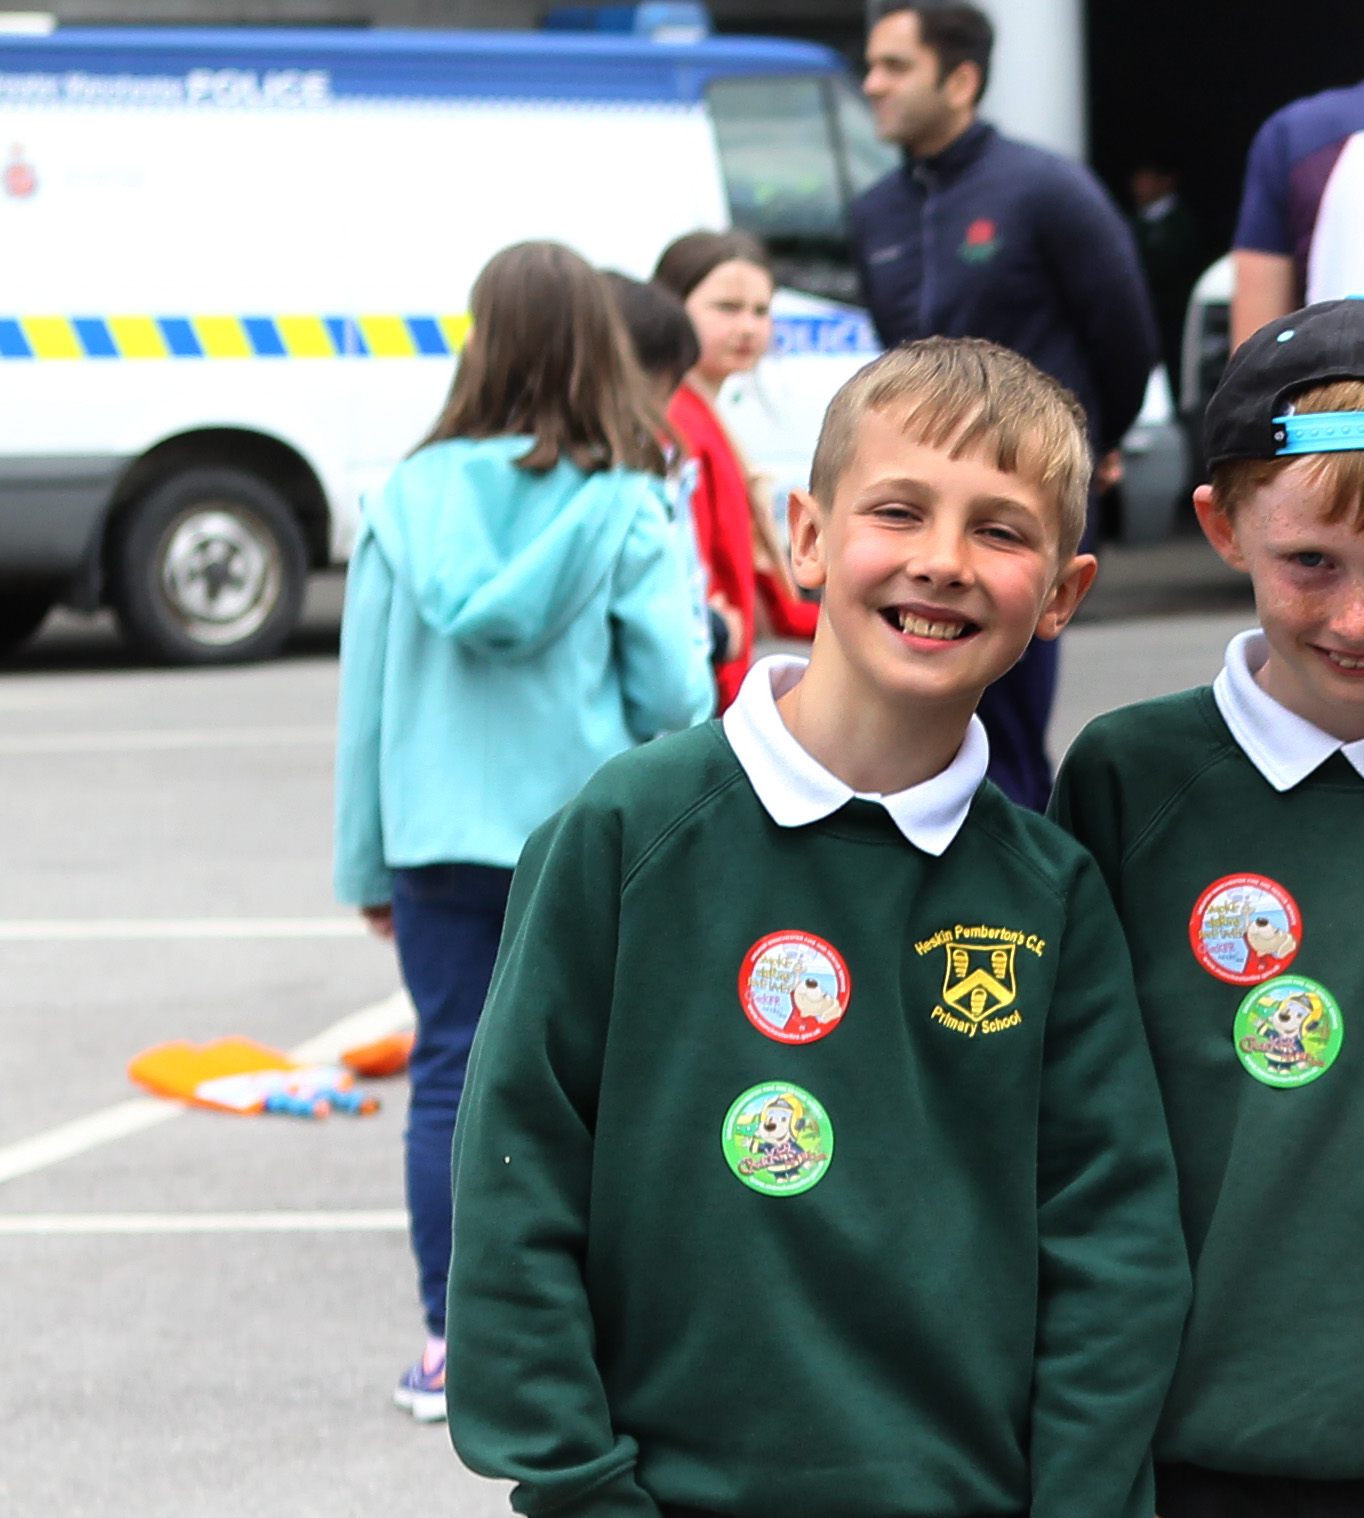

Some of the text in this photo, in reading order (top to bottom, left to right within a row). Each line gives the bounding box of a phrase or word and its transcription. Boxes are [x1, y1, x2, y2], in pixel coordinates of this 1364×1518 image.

[914, 929, 954, 956] Heskin
[954, 924, 1026, 946] Pemberton's
[930, 1005, 1023, 1038] Primary School
